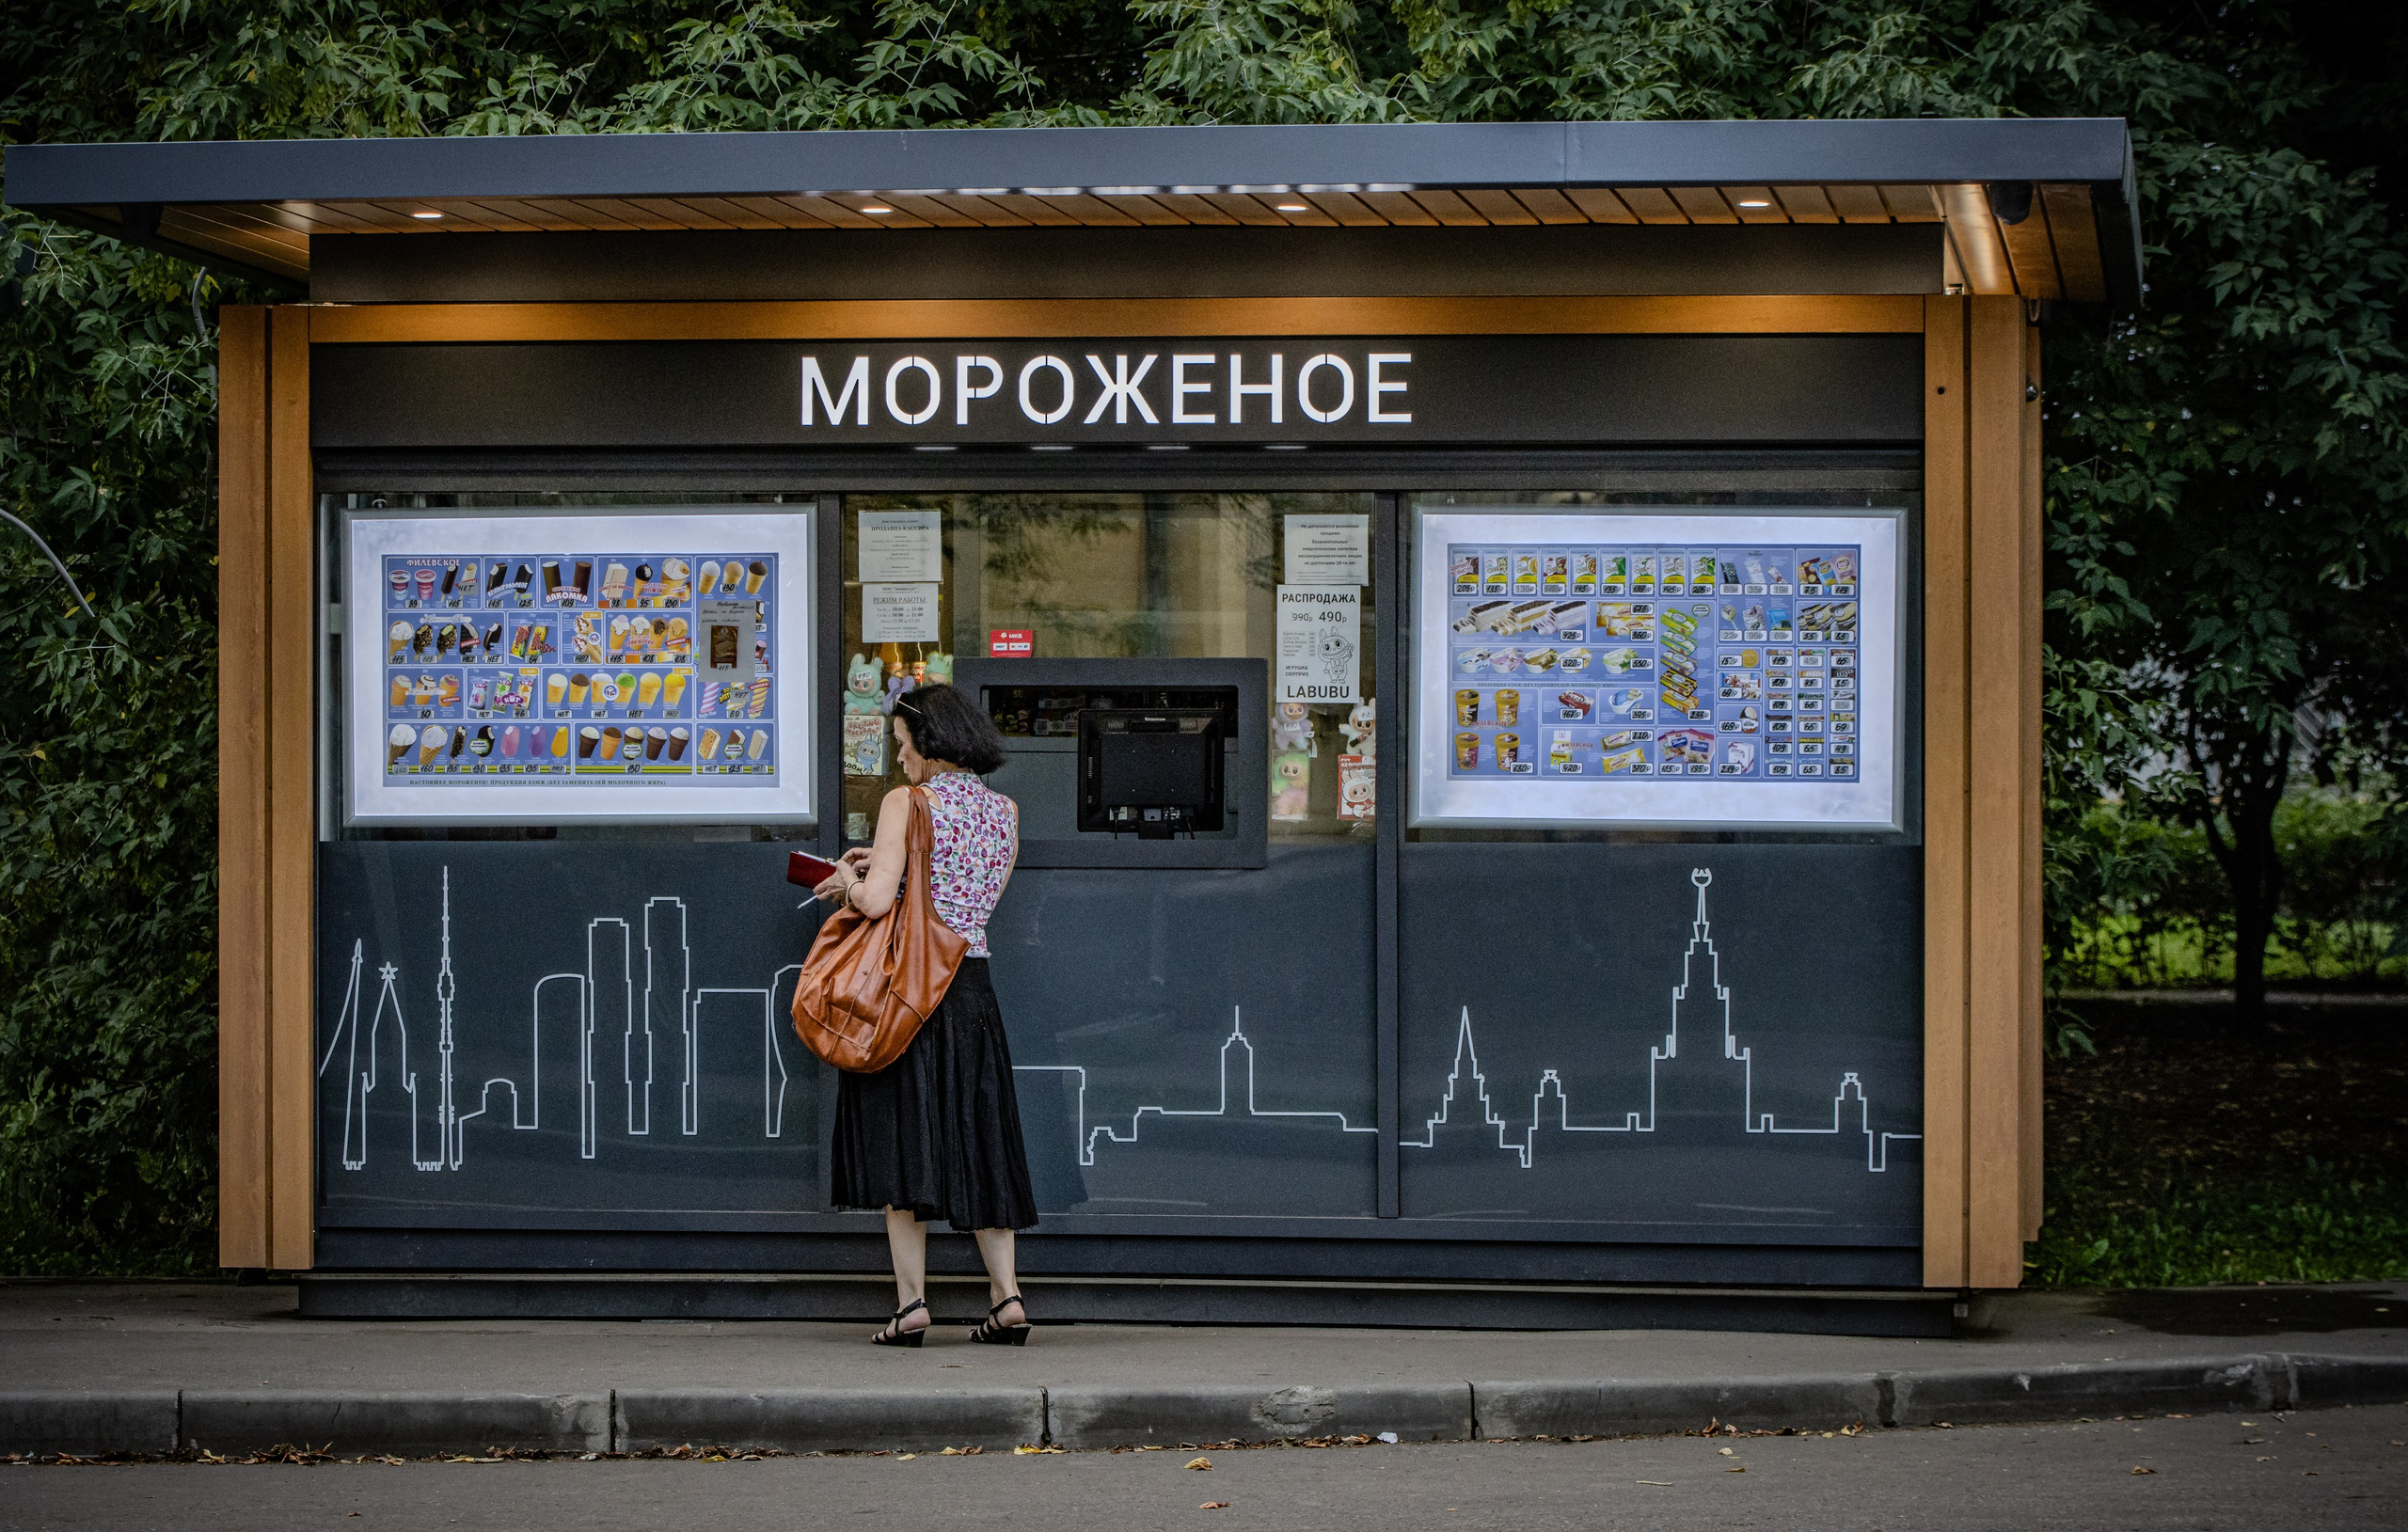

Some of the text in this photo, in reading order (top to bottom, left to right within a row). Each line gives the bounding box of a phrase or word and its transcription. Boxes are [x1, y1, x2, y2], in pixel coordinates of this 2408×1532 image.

[801, 354, 1412, 425] МОРОЖЕНОЕ
[546, 592, 588, 603] ЛАКОМКА
[1282, 593, 1355, 604] РАСПРОДАЖА
[448, 599, 460, 608] 115
[518, 599, 532, 608] 125
[562, 599, 574, 608] 109
[1319, 611, 1347, 624] 490р
[1287, 686, 1350, 698] LABUBU
[1835, 723, 1846, 732] 69
